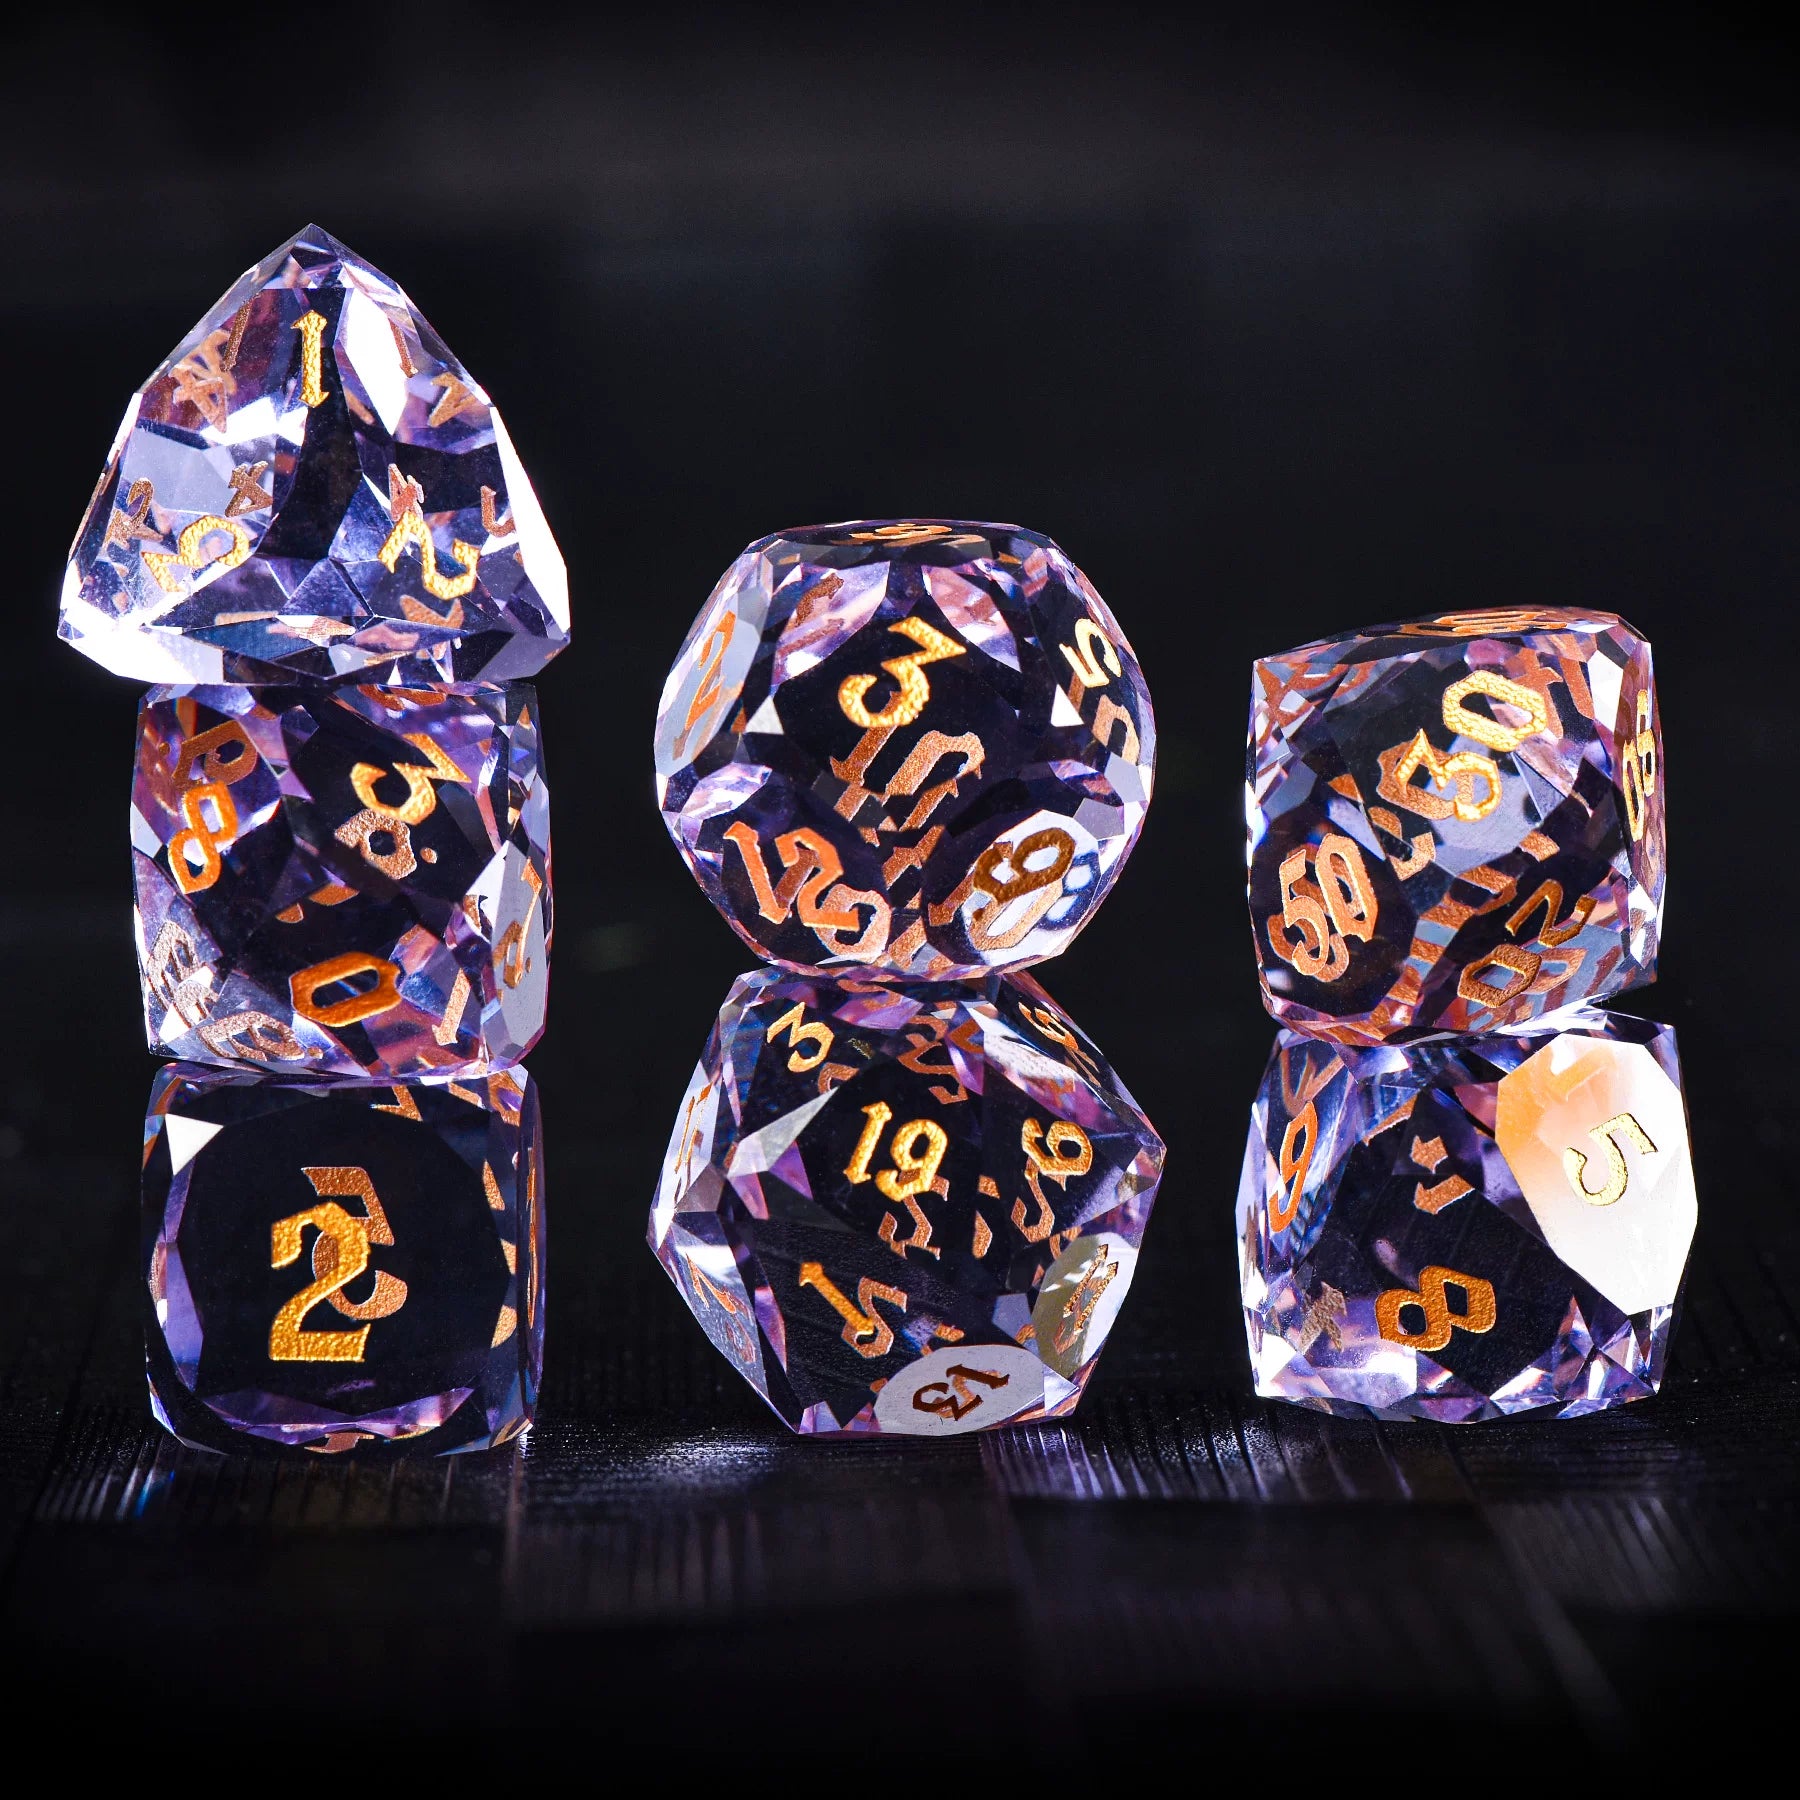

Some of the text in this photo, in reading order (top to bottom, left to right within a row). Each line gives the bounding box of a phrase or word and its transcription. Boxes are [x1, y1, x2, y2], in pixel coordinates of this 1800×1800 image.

[291, 310, 329, 408] 1
[141, 514, 251, 592] 3
[377, 510, 480, 600] 2
[838, 616, 967, 728] 3
[1059, 618, 1122, 688] 5
[349, 733, 472, 825] 3
[1394, 669, 1546, 822] 30
[168, 779, 239, 894] 8
[723, 821, 860, 931] 12
[1279, 833, 1379, 976] 50
[1458, 879, 1598, 1008] 20
[290, 951, 403, 1028] 0
[766, 1002, 835, 1073] 3
[843, 1101, 948, 1201] 19
[1562, 1112, 1658, 1207] 5
[268, 1201, 371, 1363] 2
[799, 1261, 875, 1336] 1
[1063, 1243, 1119, 1336] 11
[1374, 1265, 1497, 1352] 8
[912, 1364, 1010, 1421] 13
